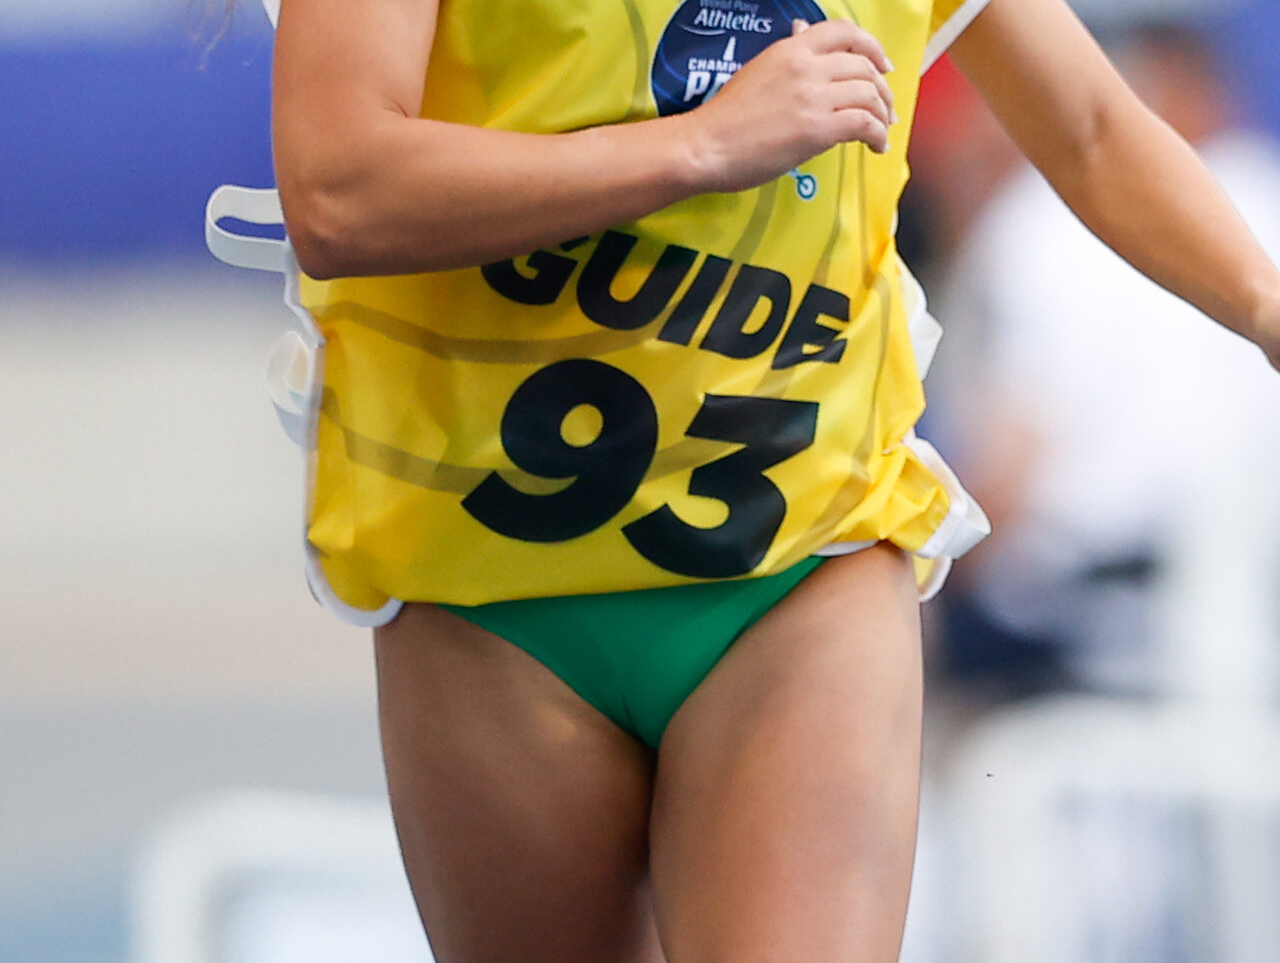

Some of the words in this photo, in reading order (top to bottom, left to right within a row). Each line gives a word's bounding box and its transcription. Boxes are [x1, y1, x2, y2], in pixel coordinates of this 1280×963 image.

[694, 8, 774, 34] Athletics
[480, 230, 850, 370] GUIDE
[461, 358, 820, 579] 93
